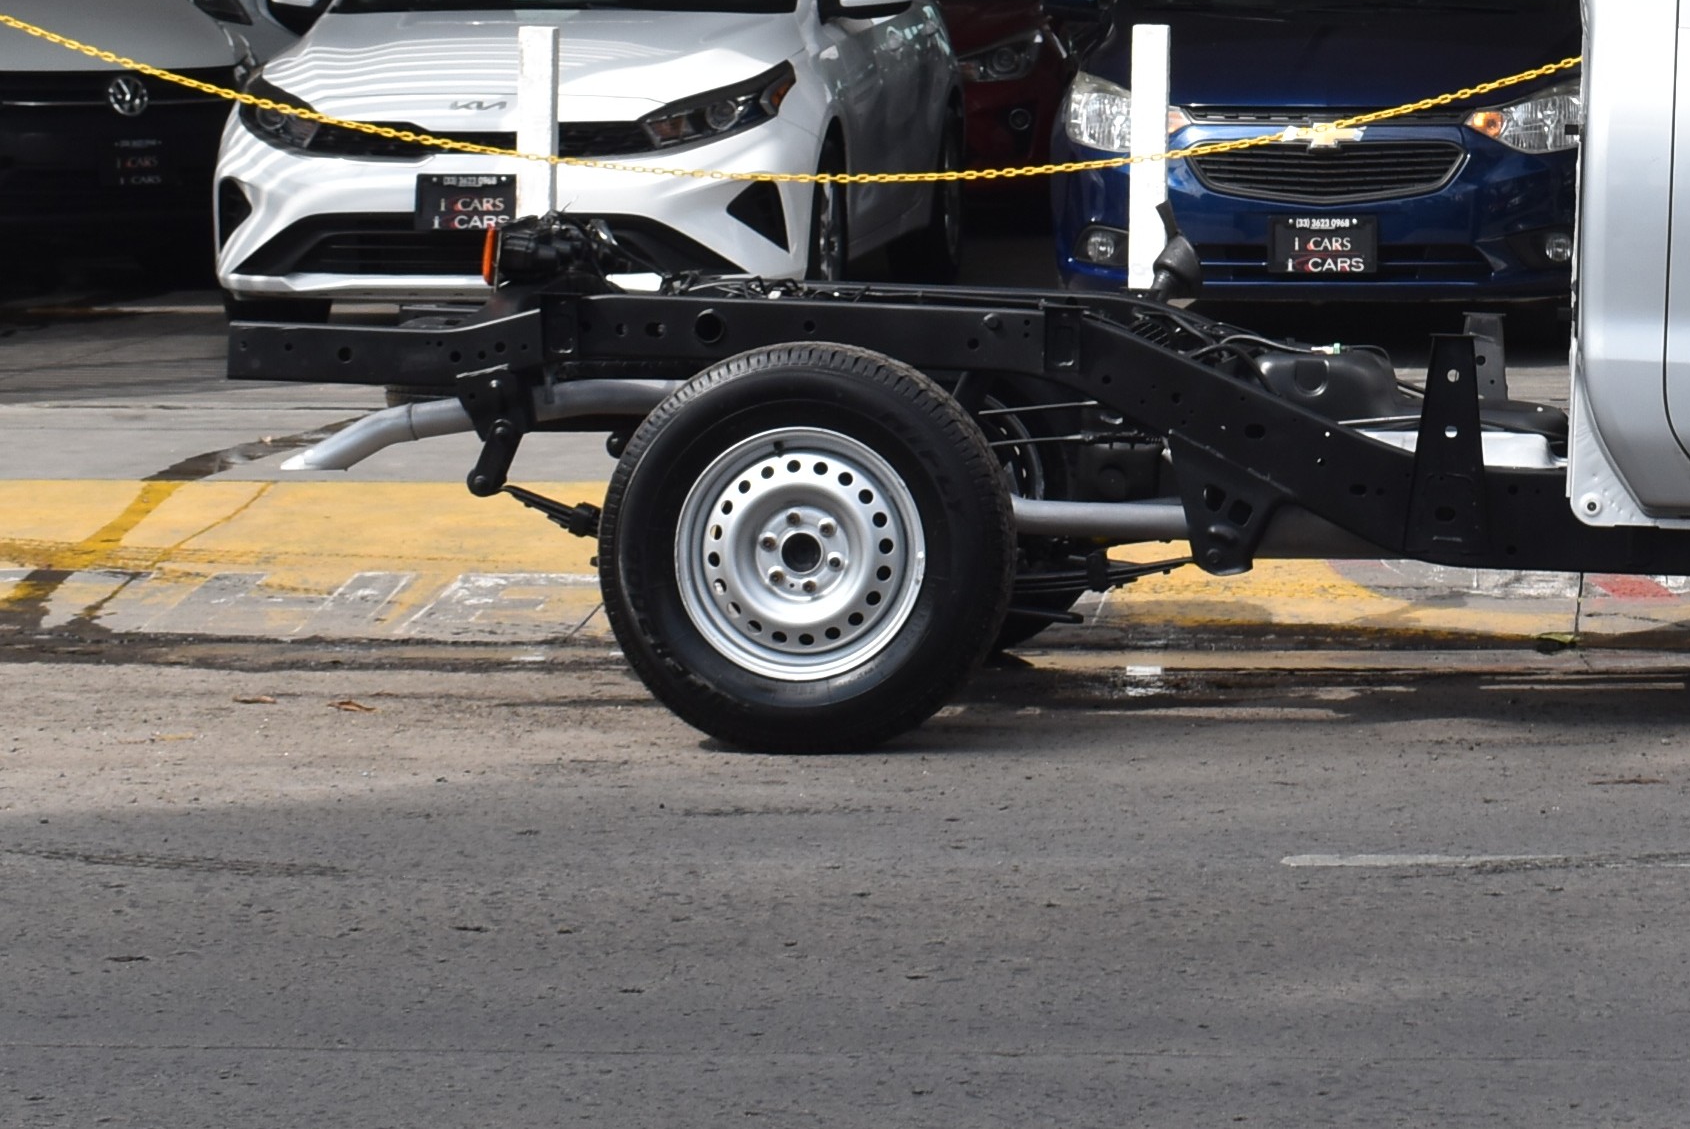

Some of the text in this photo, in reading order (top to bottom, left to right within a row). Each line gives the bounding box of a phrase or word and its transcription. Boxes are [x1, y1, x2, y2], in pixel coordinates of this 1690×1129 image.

[457, 197, 505, 212] CARS
[1296, 217, 1350, 229] (33) 3623 0968
[1309, 236, 1352, 252] CARS
[1307, 257, 1365, 273] CARS
